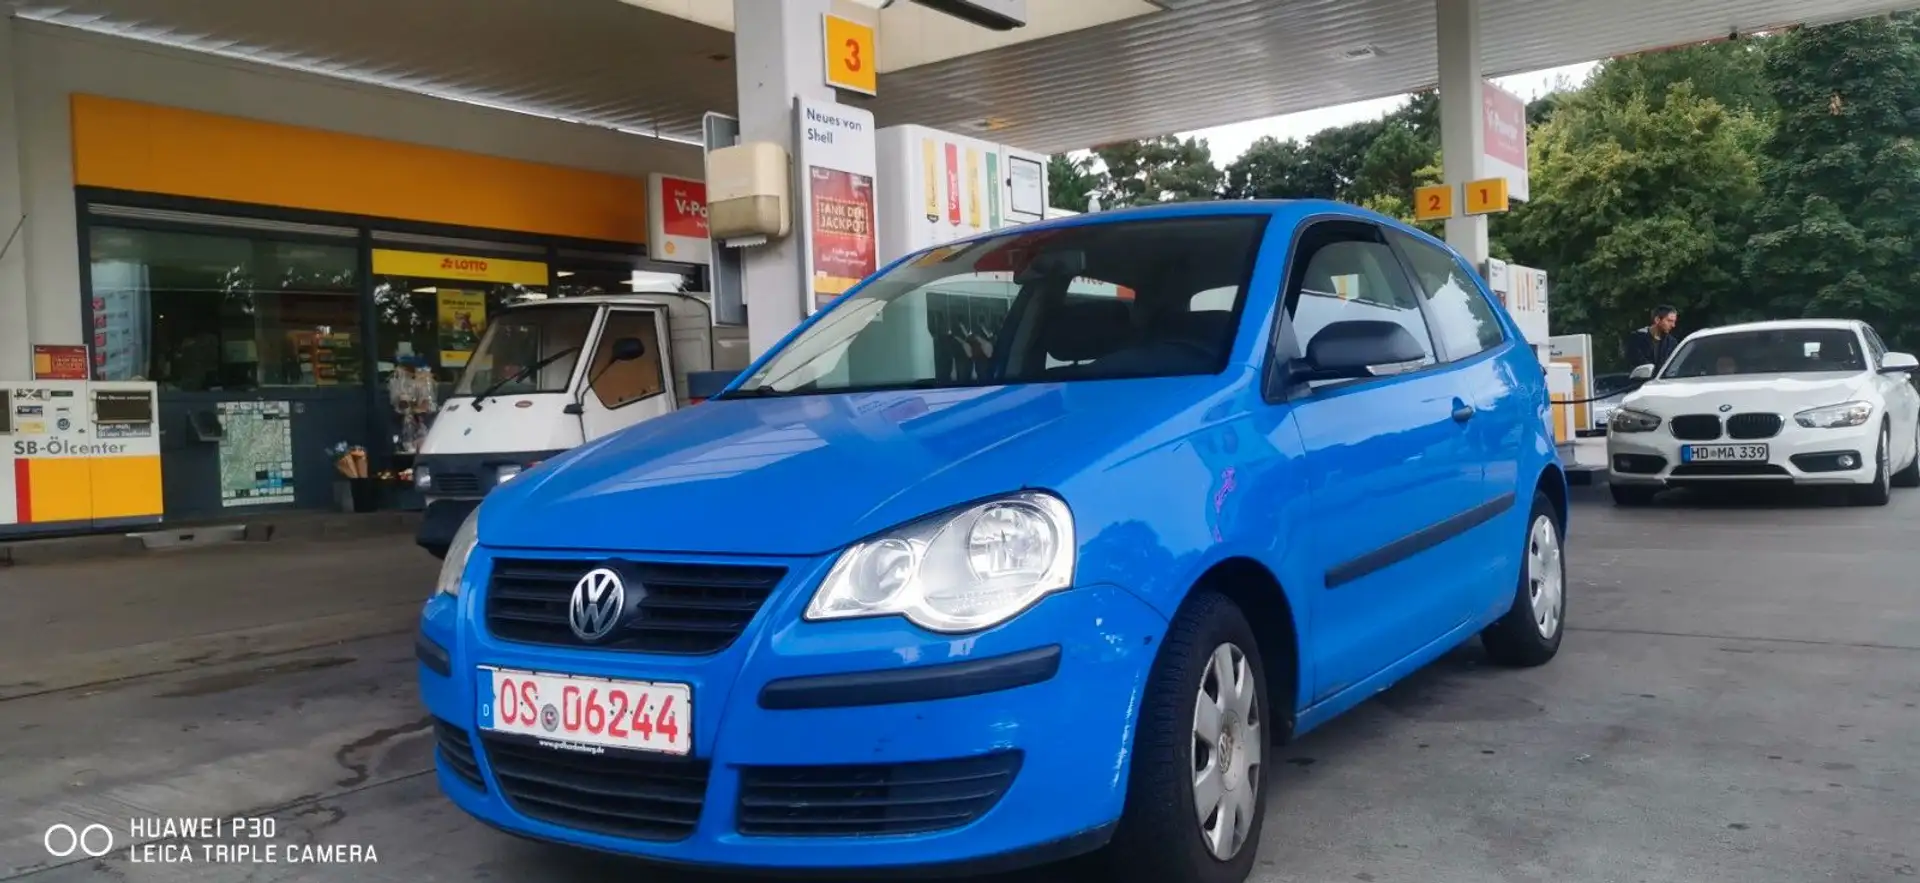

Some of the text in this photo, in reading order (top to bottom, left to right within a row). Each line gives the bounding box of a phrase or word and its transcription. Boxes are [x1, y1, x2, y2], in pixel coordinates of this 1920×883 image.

[844, 38, 861, 72] 3
[806, 107, 862, 131] Neues von
[807, 127, 833, 144] Shell
[1428, 194, 1443, 211] 2
[1479, 188, 1488, 204] 1
[675, 198, 708, 218] V-Po
[819, 201, 846, 217] TANK
[819, 214, 866, 233] JACKPOT
[454, 259, 488, 272] LOTTO
[13, 435, 128, 455] SB-Ölcenter
[1691, 446, 1765, 459] HD MA 339
[500, 677, 538, 727] OS
[562, 685, 678, 744] 06244
